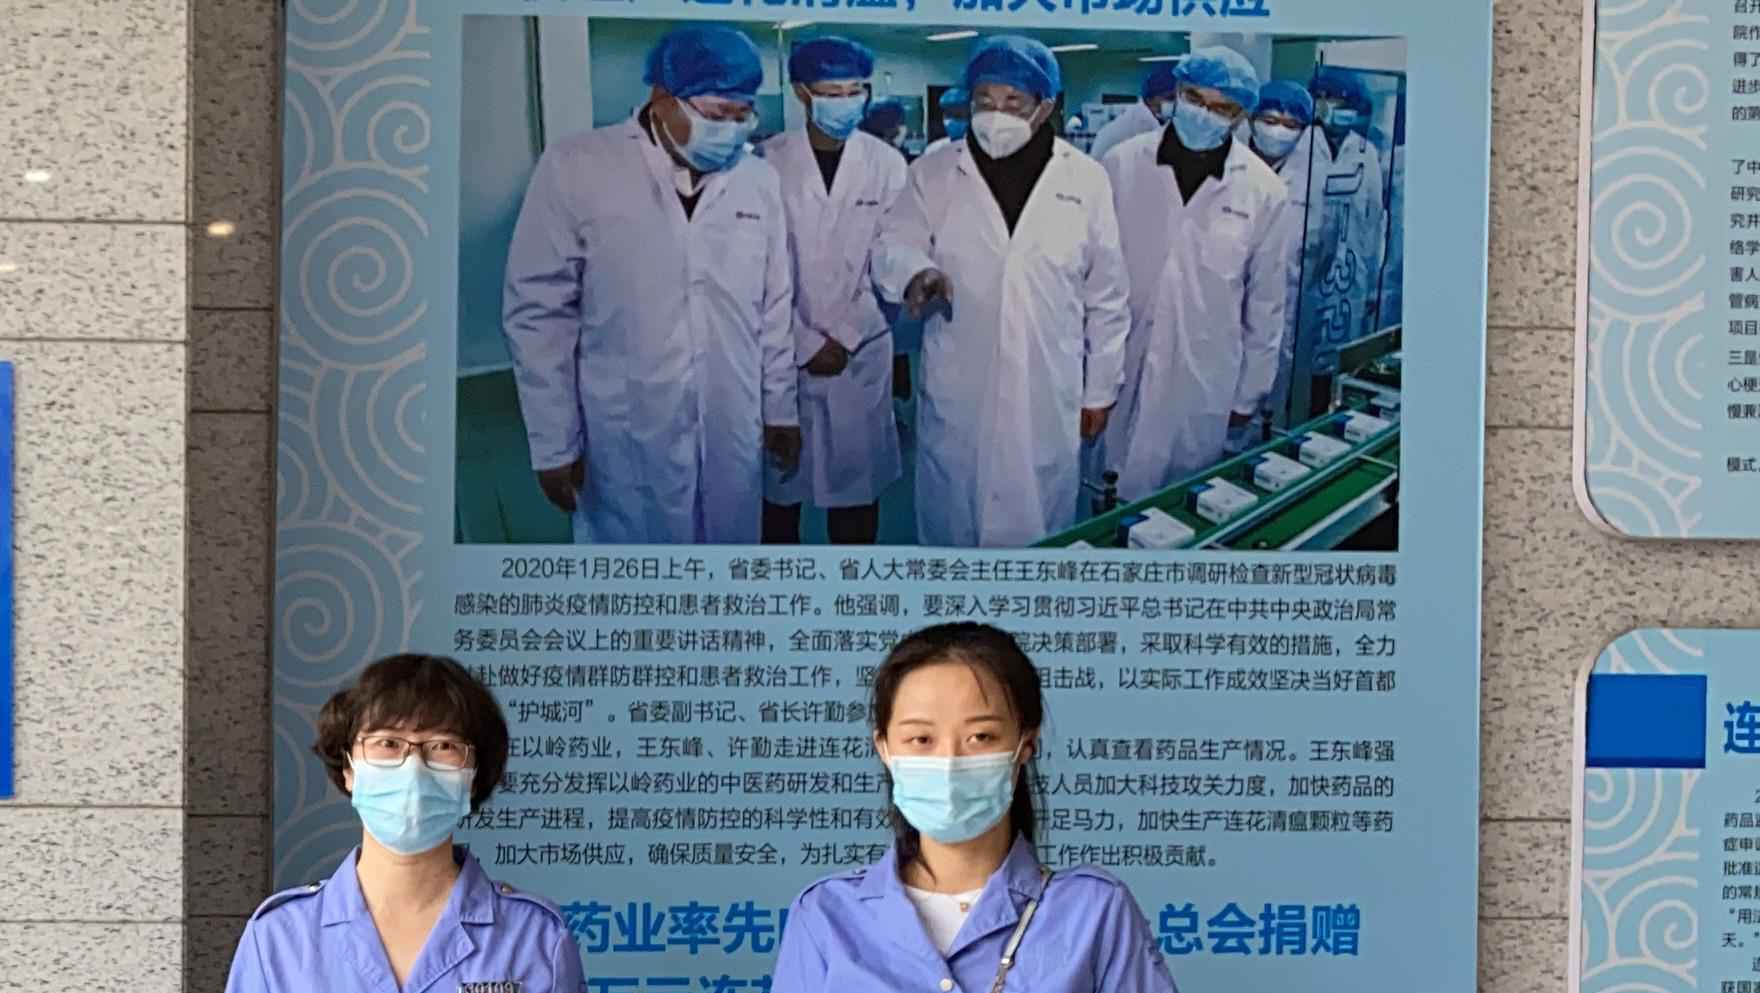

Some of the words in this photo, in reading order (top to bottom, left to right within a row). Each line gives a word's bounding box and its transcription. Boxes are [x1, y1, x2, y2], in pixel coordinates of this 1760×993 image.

[1728, 320, 1760, 336] 项目
[1728, 350, 1760, 366] 三是
[1727, 376, 1760, 393] 心梗
[453, 628, 913, 655] 务委员会会议上的重要讲话精神，全面落实党
[508, 699, 877, 724] “护城河”。省委副书记、省长许勤参
[560, 901, 789, 954] 药业率先
[1157, 902, 1361, 956] 总会捐赠
